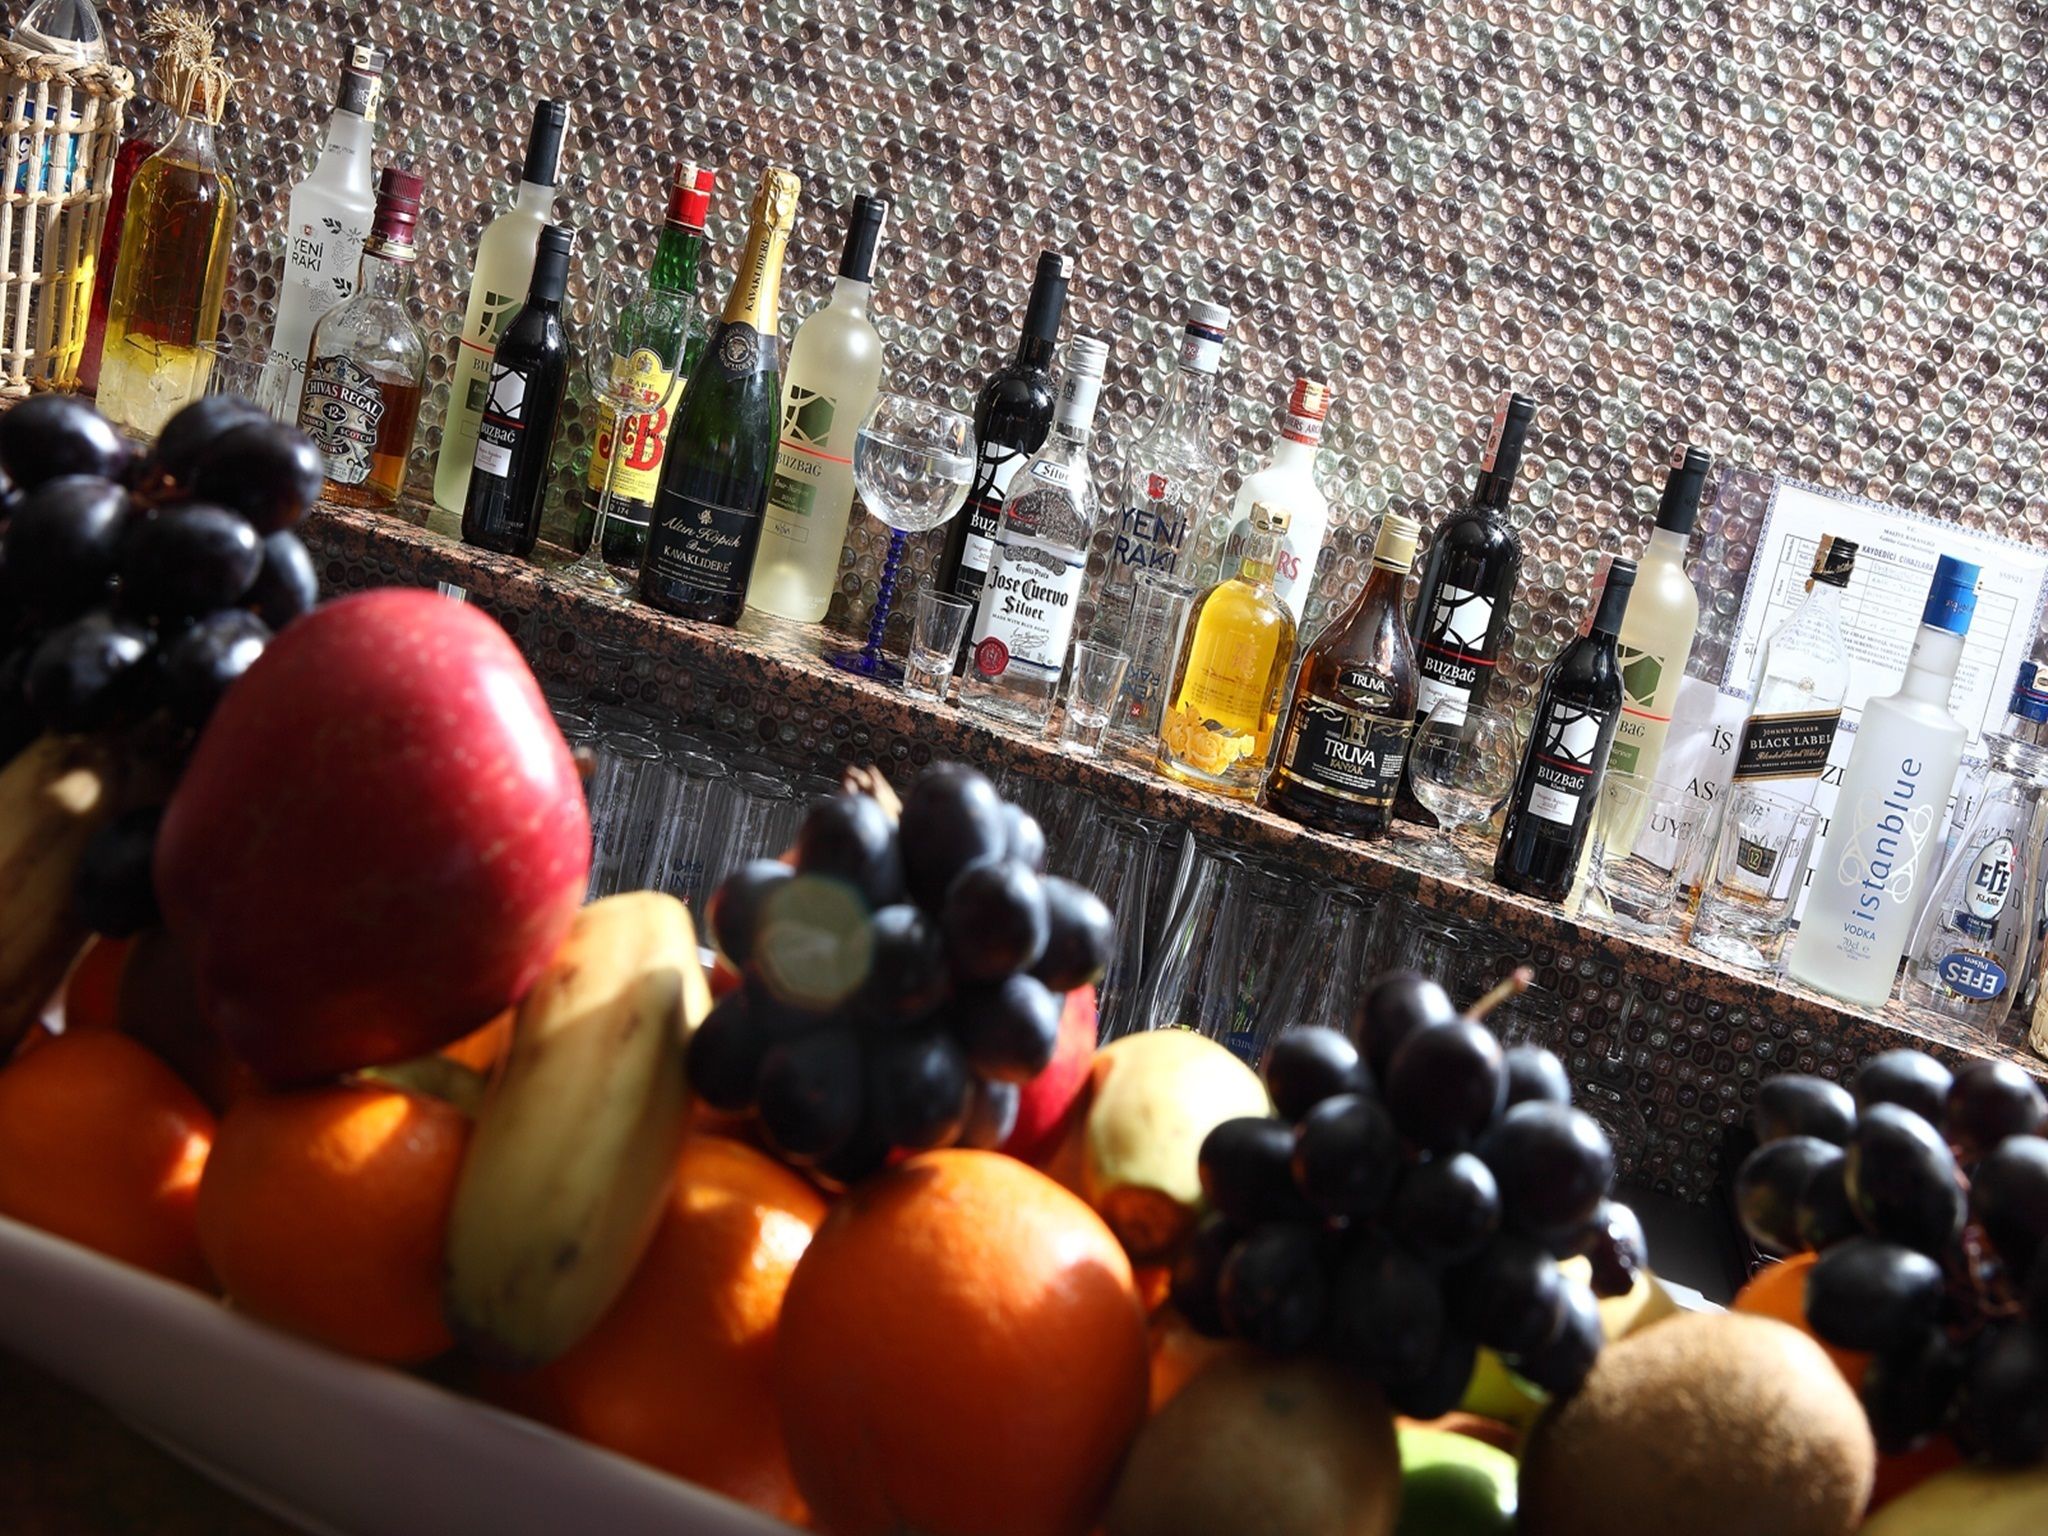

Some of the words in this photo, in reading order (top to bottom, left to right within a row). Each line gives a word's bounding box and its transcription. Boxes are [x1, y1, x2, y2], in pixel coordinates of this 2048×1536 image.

[292, 237, 324, 258] YENİ
[291, 252, 321, 272] RAKI
[744, 238, 770, 311] KAVAKLIDERE
[306, 381, 339, 397] CHIVAS
[340, 387, 379, 417] REGAL
[327, 405, 339, 418] 12
[340, 428, 373, 442] SCOTCH
[970, 514, 997, 532] BUZ
[1121, 503, 1188, 549] YENİ
[686, 539, 712, 554] Brut
[1114, 535, 1177, 576] RAKI
[663, 545, 730, 573] KAVAKLIDERE
[988, 565, 1020, 592] Jose
[1021, 578, 1069, 607] Cuervo
[1001, 595, 1044, 620] Silver
[1352, 672, 1386, 693] TRUVA
[1750, 737, 1790, 750] BLACK
[1794, 733, 1832, 747] LABEL
[1324, 737, 1377, 769] TRUVA
[1329, 758, 1366, 776] KANYAK
[1852, 757, 1922, 922] istanblue
[1844, 922, 1876, 941] VODKA
[1964, 956, 1989, 971] Pilsen
[1945, 961, 1999, 995] EFES
